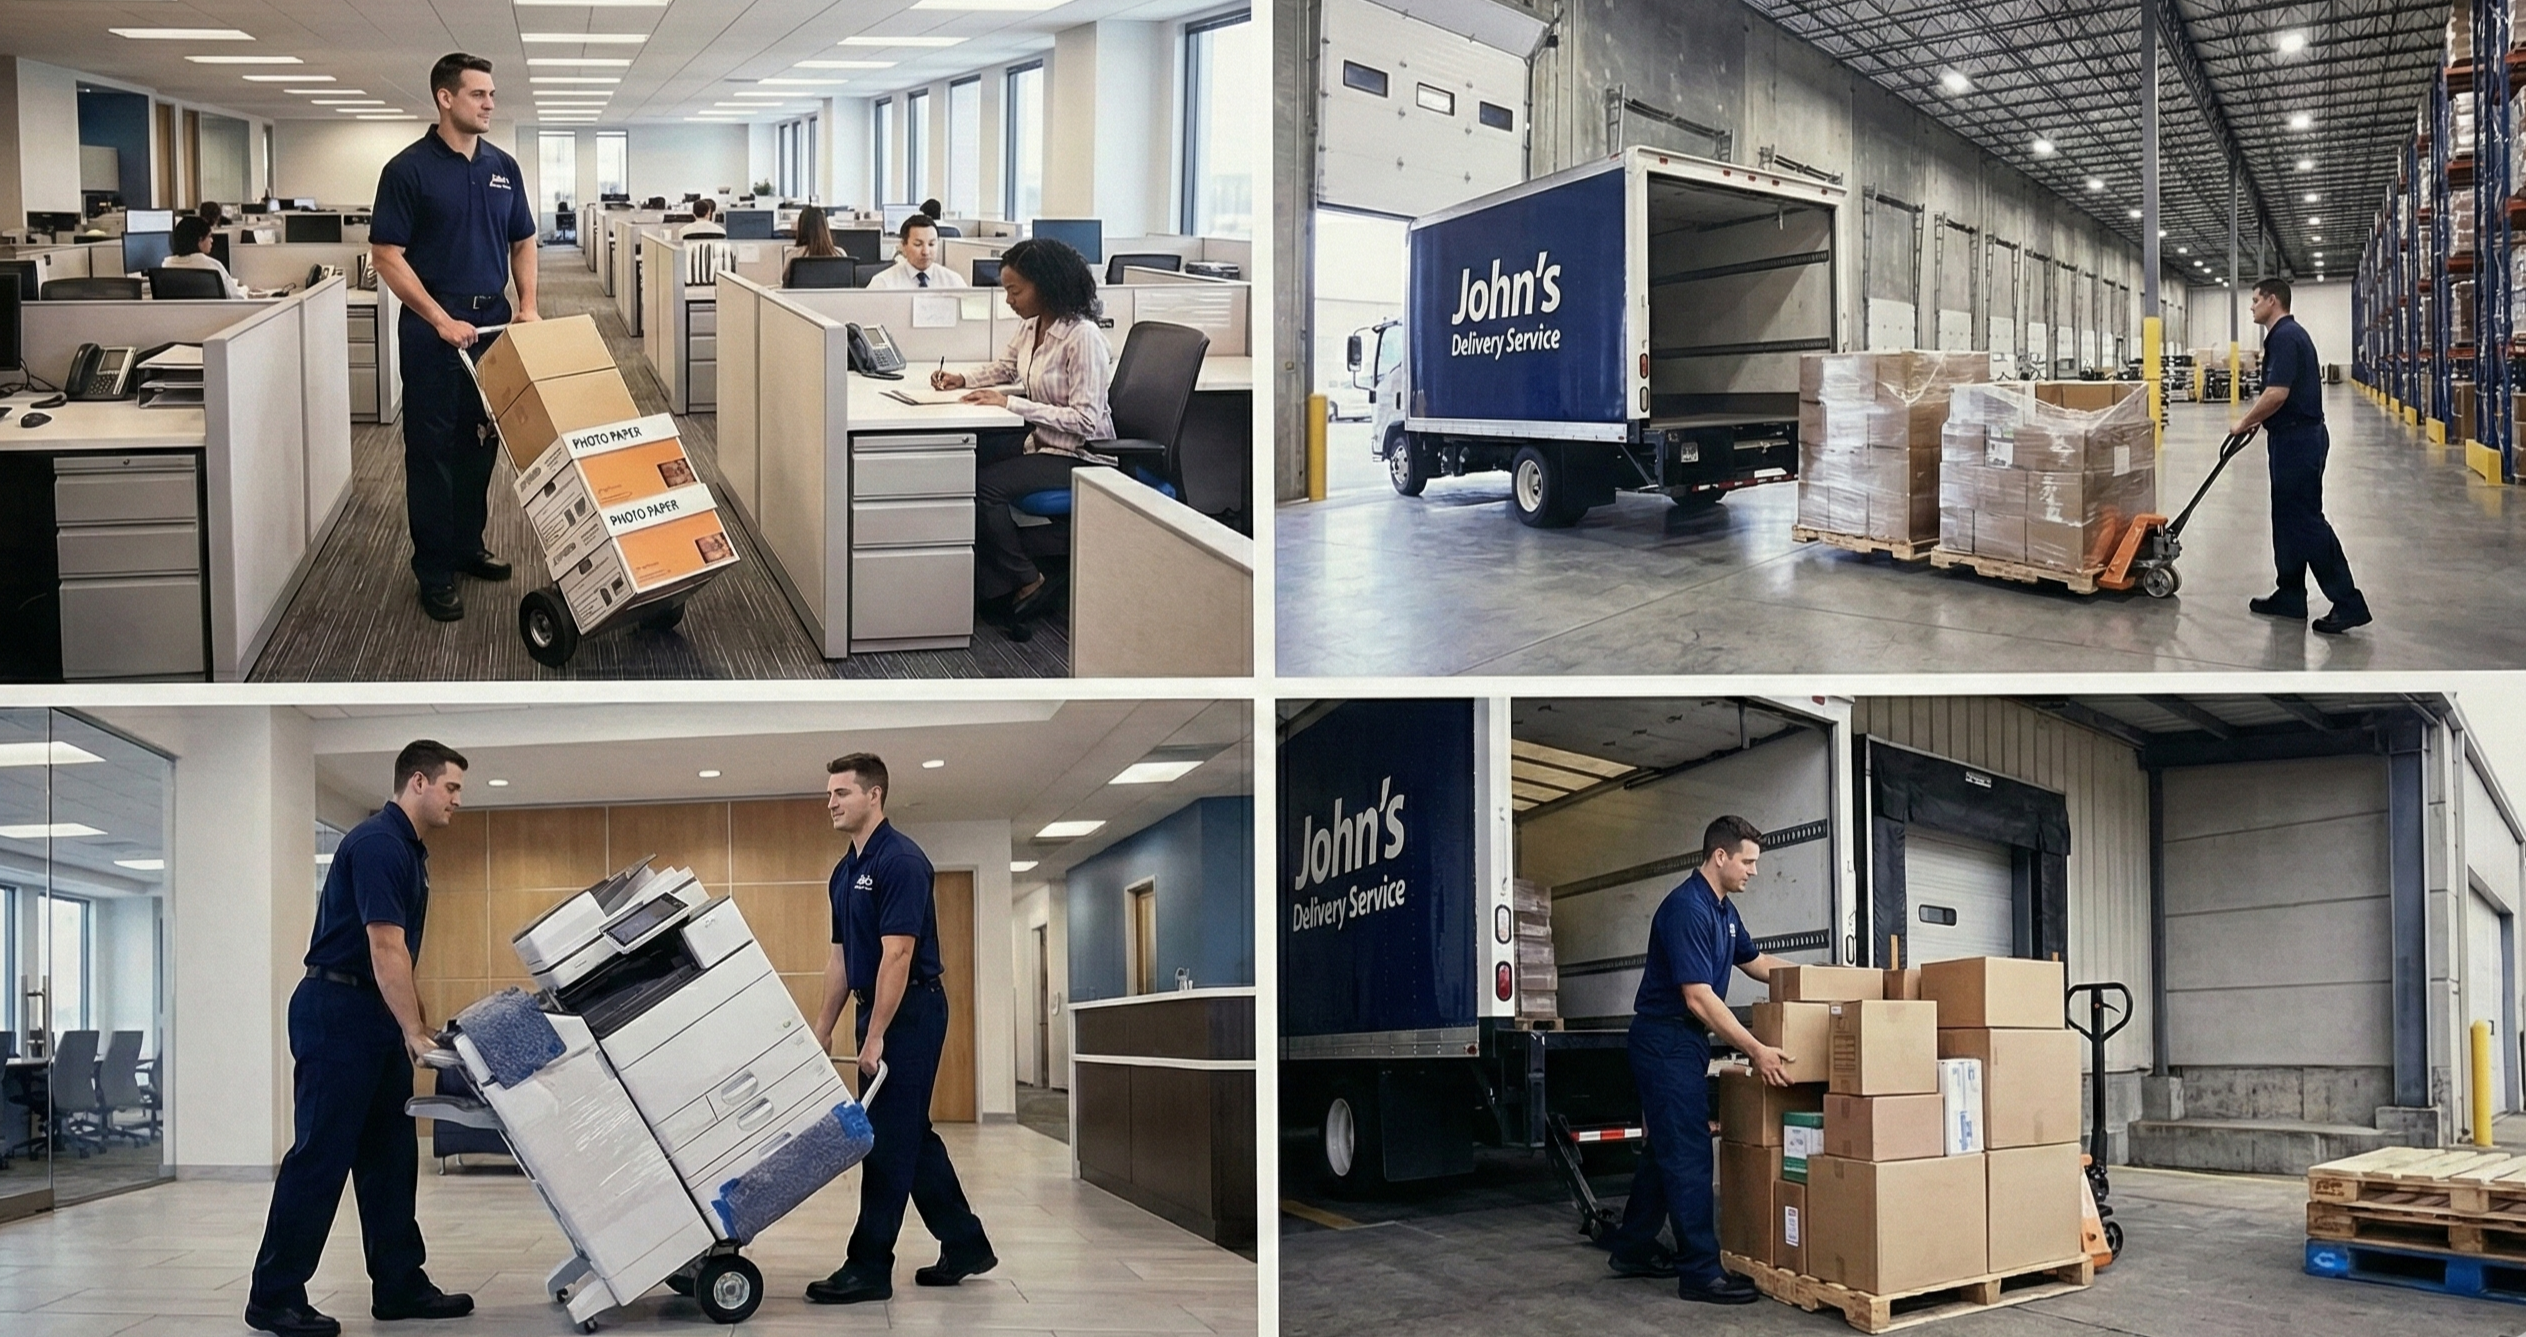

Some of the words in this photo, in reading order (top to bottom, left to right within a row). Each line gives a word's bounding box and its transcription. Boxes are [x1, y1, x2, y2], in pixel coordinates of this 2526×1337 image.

[1451, 251, 1561, 325] John's
[1451, 331, 1505, 360] Delivery
[1506, 323, 1561, 353] Service
[572, 433, 608, 449] PHOTO
[609, 426, 642, 440] PAPER
[609, 508, 646, 526] PHOTO
[646, 499, 679, 518] PAPER
[1294, 775, 1405, 891] John's
[1293, 896, 1347, 932] Delivery
[1349, 874, 1406, 918] Service
